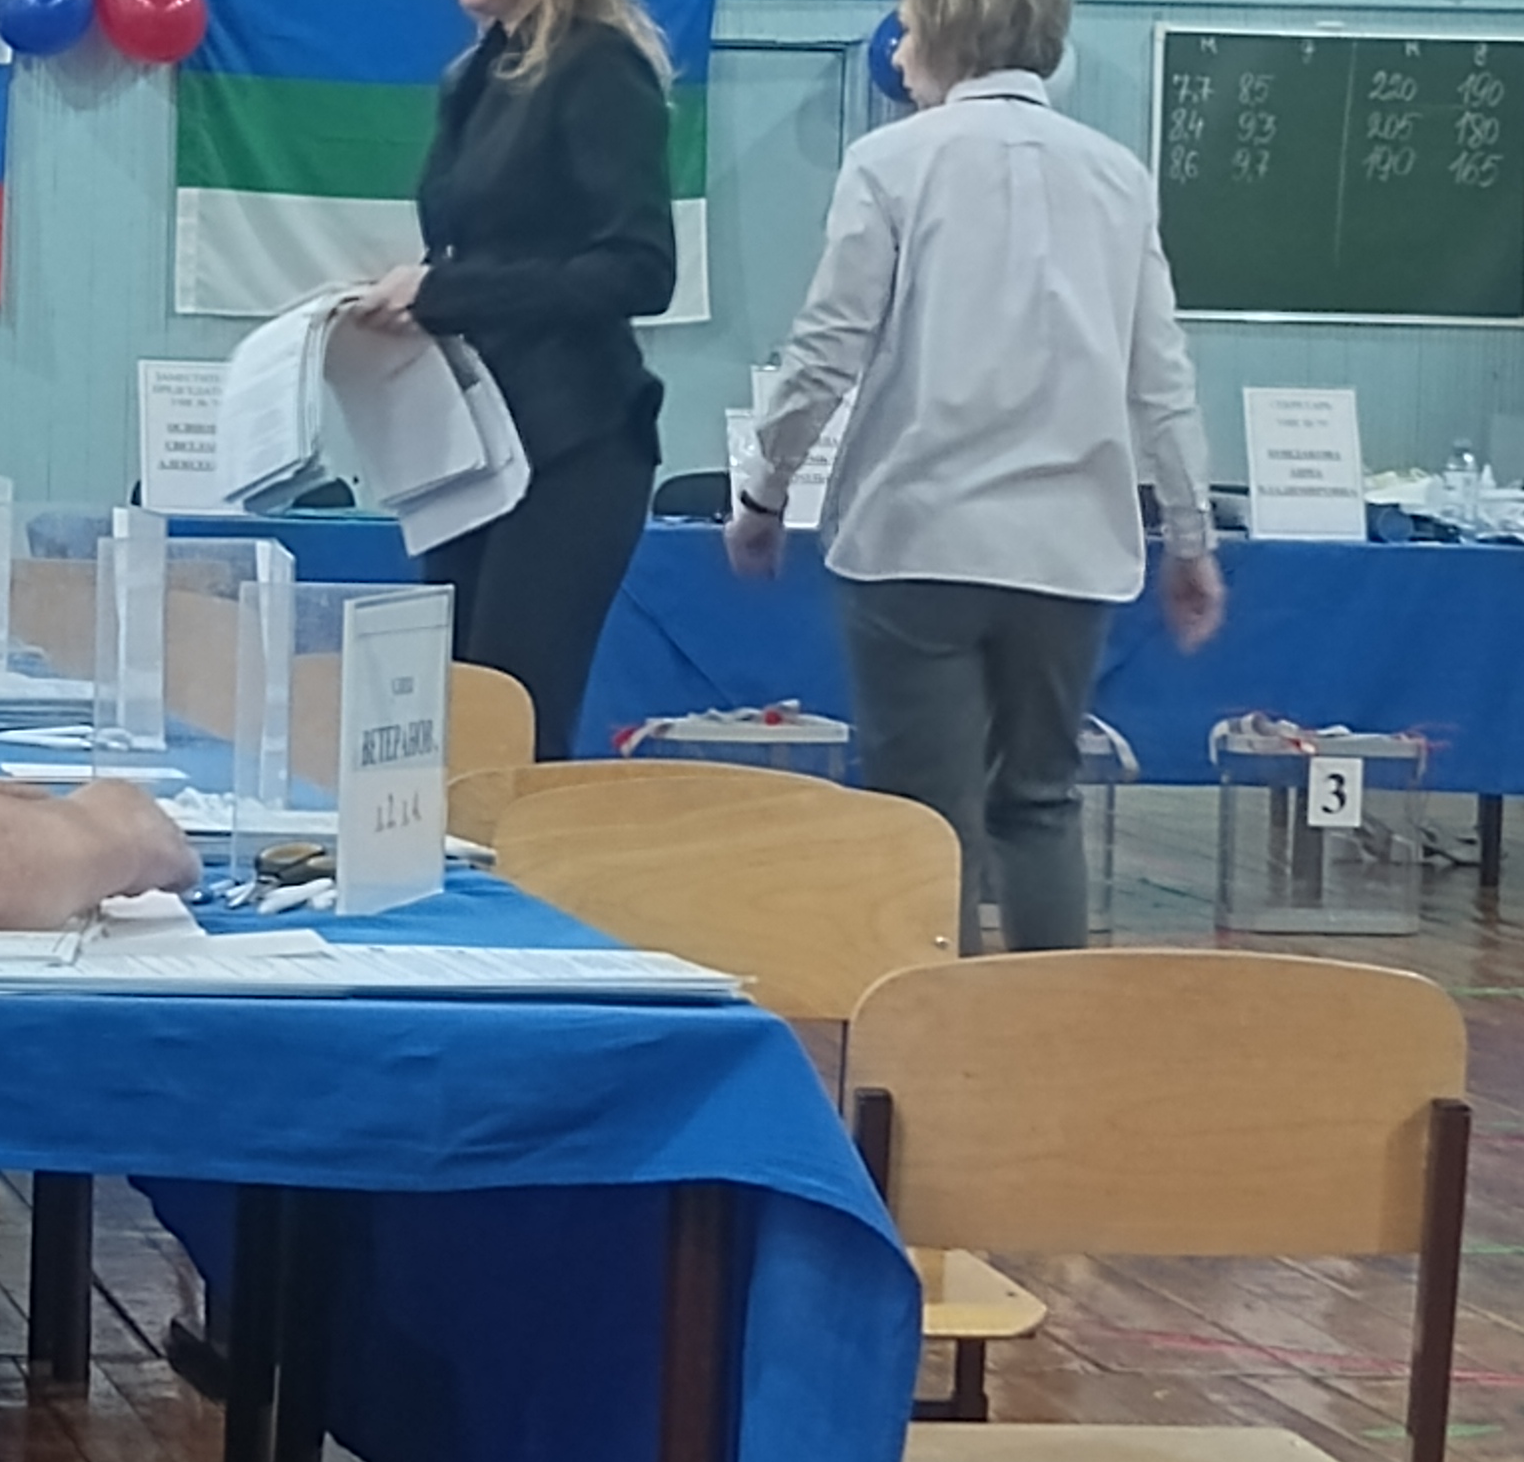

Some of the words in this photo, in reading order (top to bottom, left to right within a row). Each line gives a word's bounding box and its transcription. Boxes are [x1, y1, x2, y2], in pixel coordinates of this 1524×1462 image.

[1368, 70, 1418, 102] 220
[1457, 71, 1505, 107] 190
[1366, 110, 1423, 141] 205
[1454, 110, 1500, 149] 180
[1362, 144, 1417, 183] 190
[1448, 149, 1504, 188] 165
[1321, 773, 1347, 814] 3
